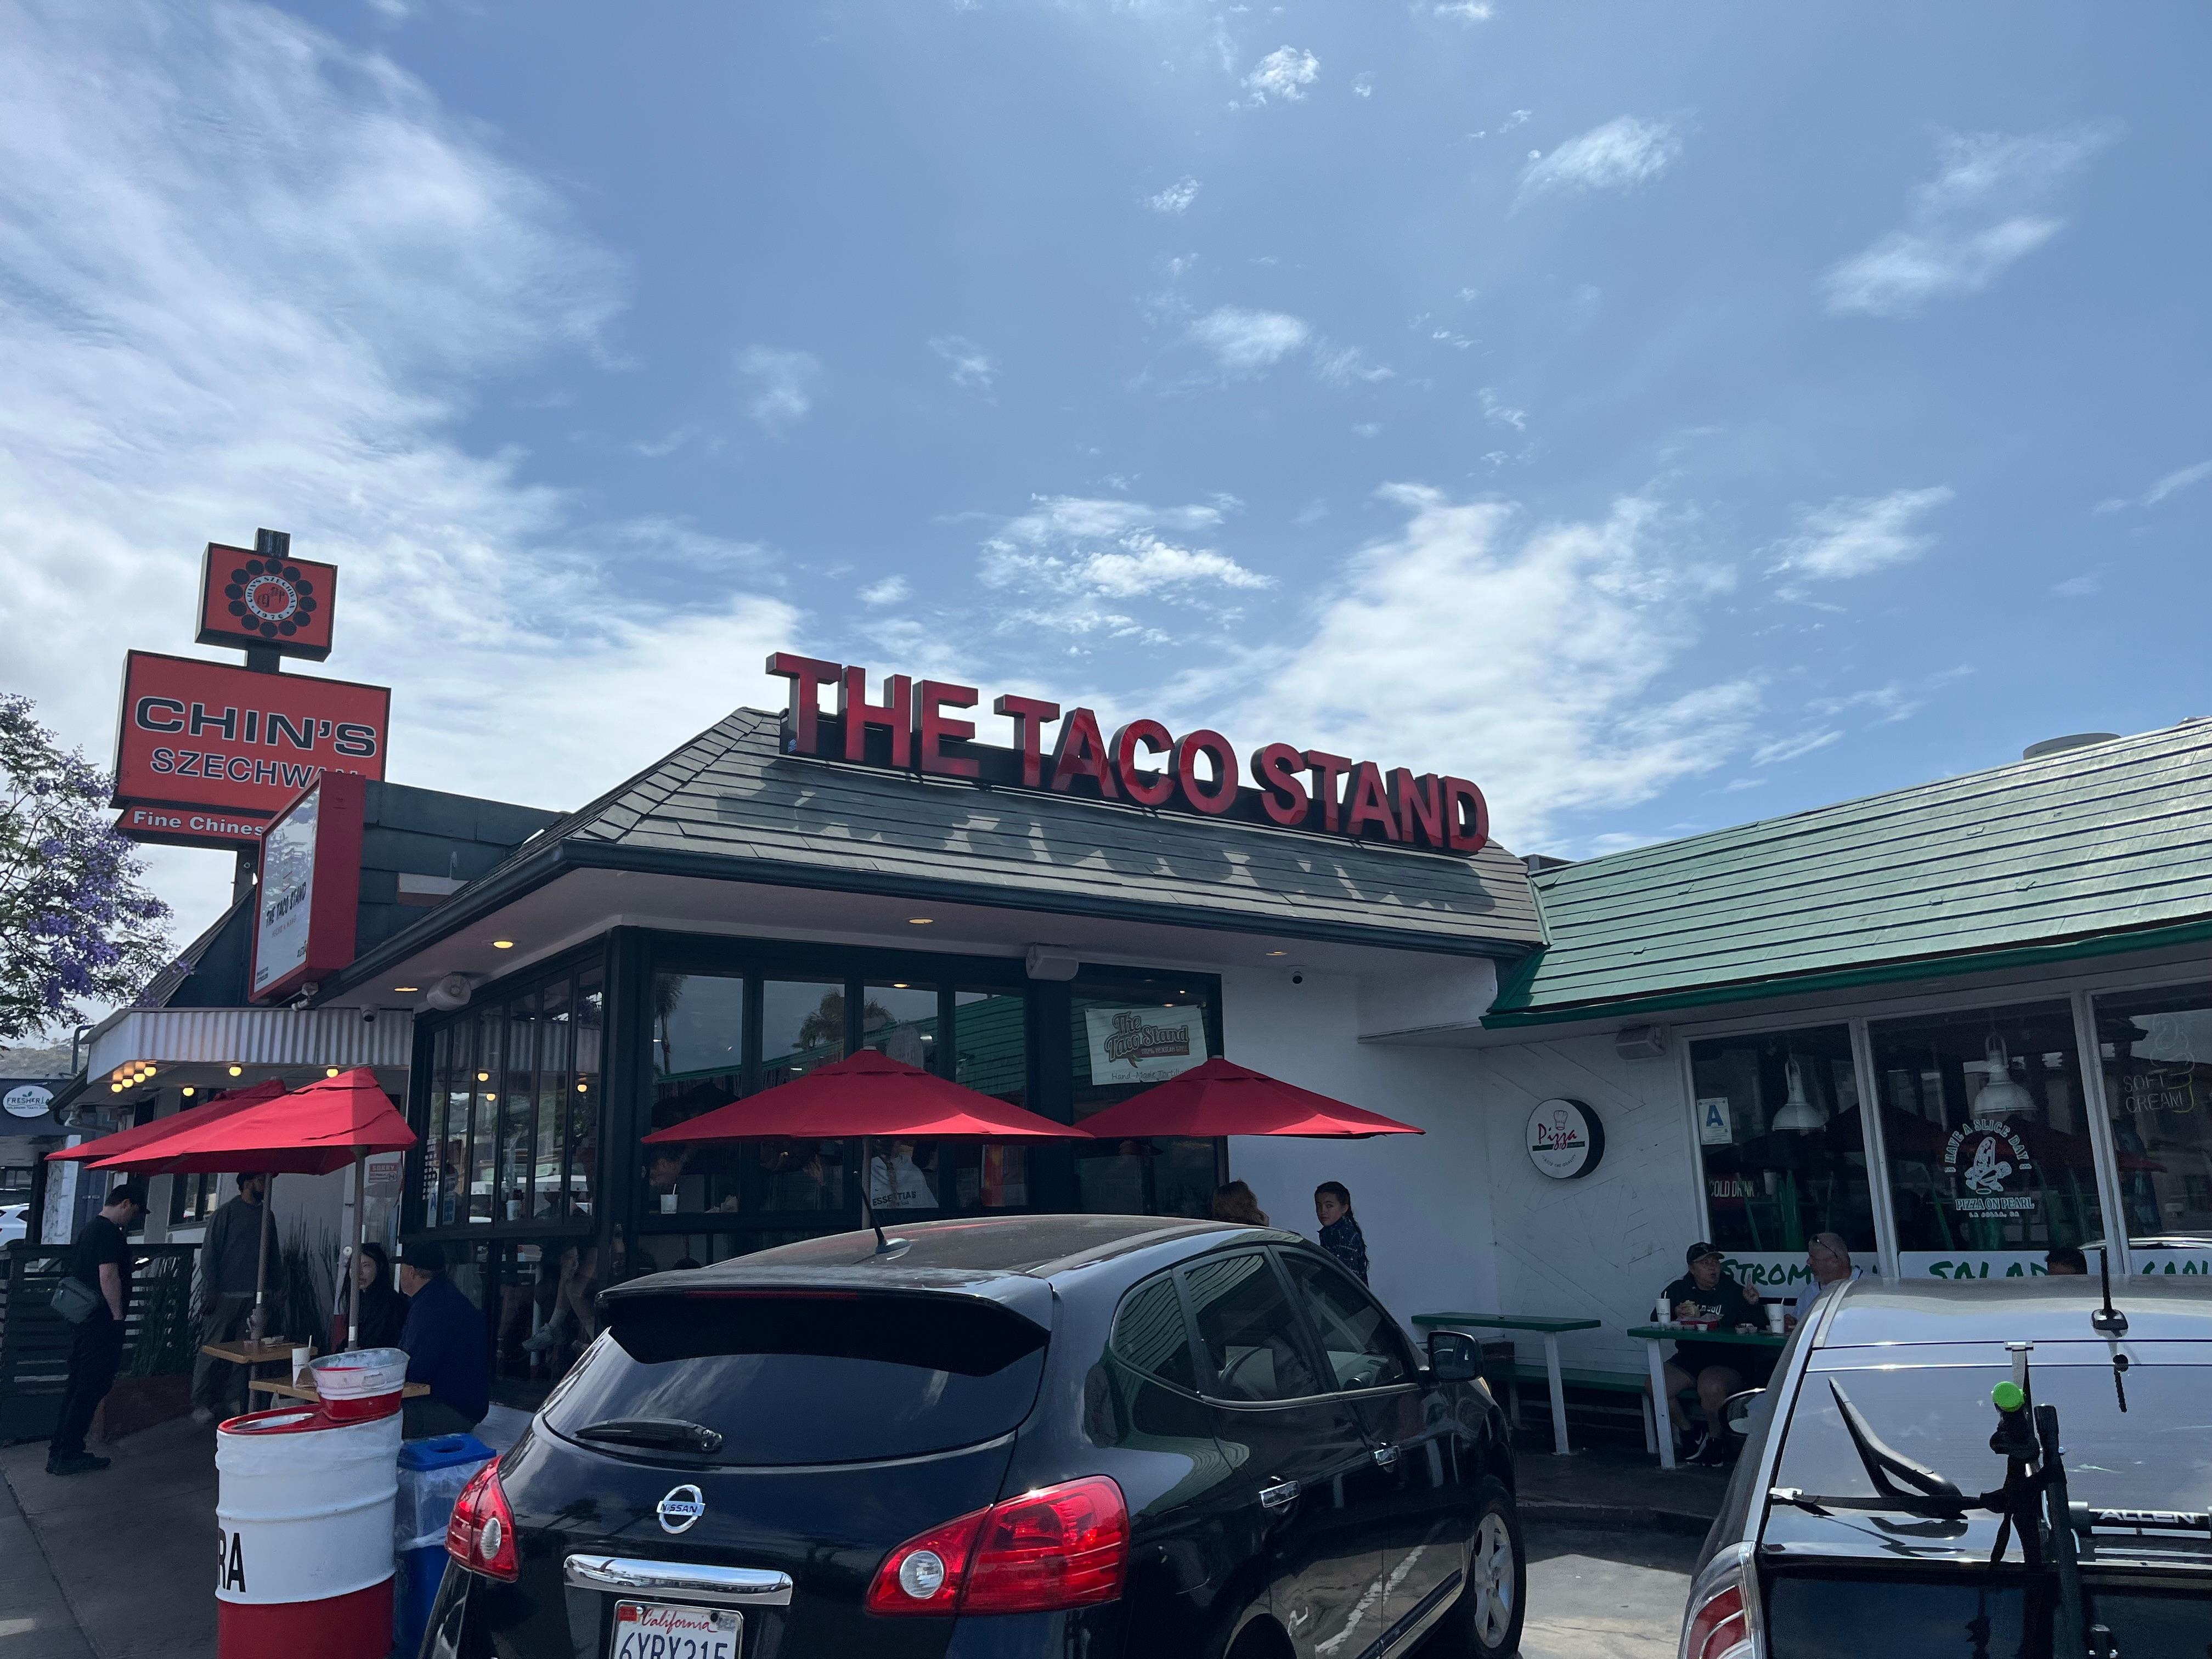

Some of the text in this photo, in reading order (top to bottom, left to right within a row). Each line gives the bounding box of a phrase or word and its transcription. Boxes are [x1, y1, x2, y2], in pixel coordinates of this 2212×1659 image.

[135, 696, 376, 758] CHIN'S
[766, 652, 1489, 856] THE TACO STAND
[150, 747, 358, 789] SZECHW
[133, 811, 263, 837] Fine Chines
[266, 906, 275, 928] THE
[276, 896, 289, 921] TACO
[289, 882, 307, 910] STAND
[1111, 1011, 1142, 1036] The
[1104, 1025, 1189, 1063] Taco Stand
[1706, 1105, 1724, 1127] A
[1538, 1123, 1577, 1150] Pizza
[1945, 1119, 2029, 1164] HAVE A SLICE DAY
[1955, 1197, 2035, 1210] PIZZA ON PEARL
[661, 1503, 697, 1513] NISSAN
[2100, 1509, 2196, 1524] ALLEN
[642, 1609, 718, 1634] California
